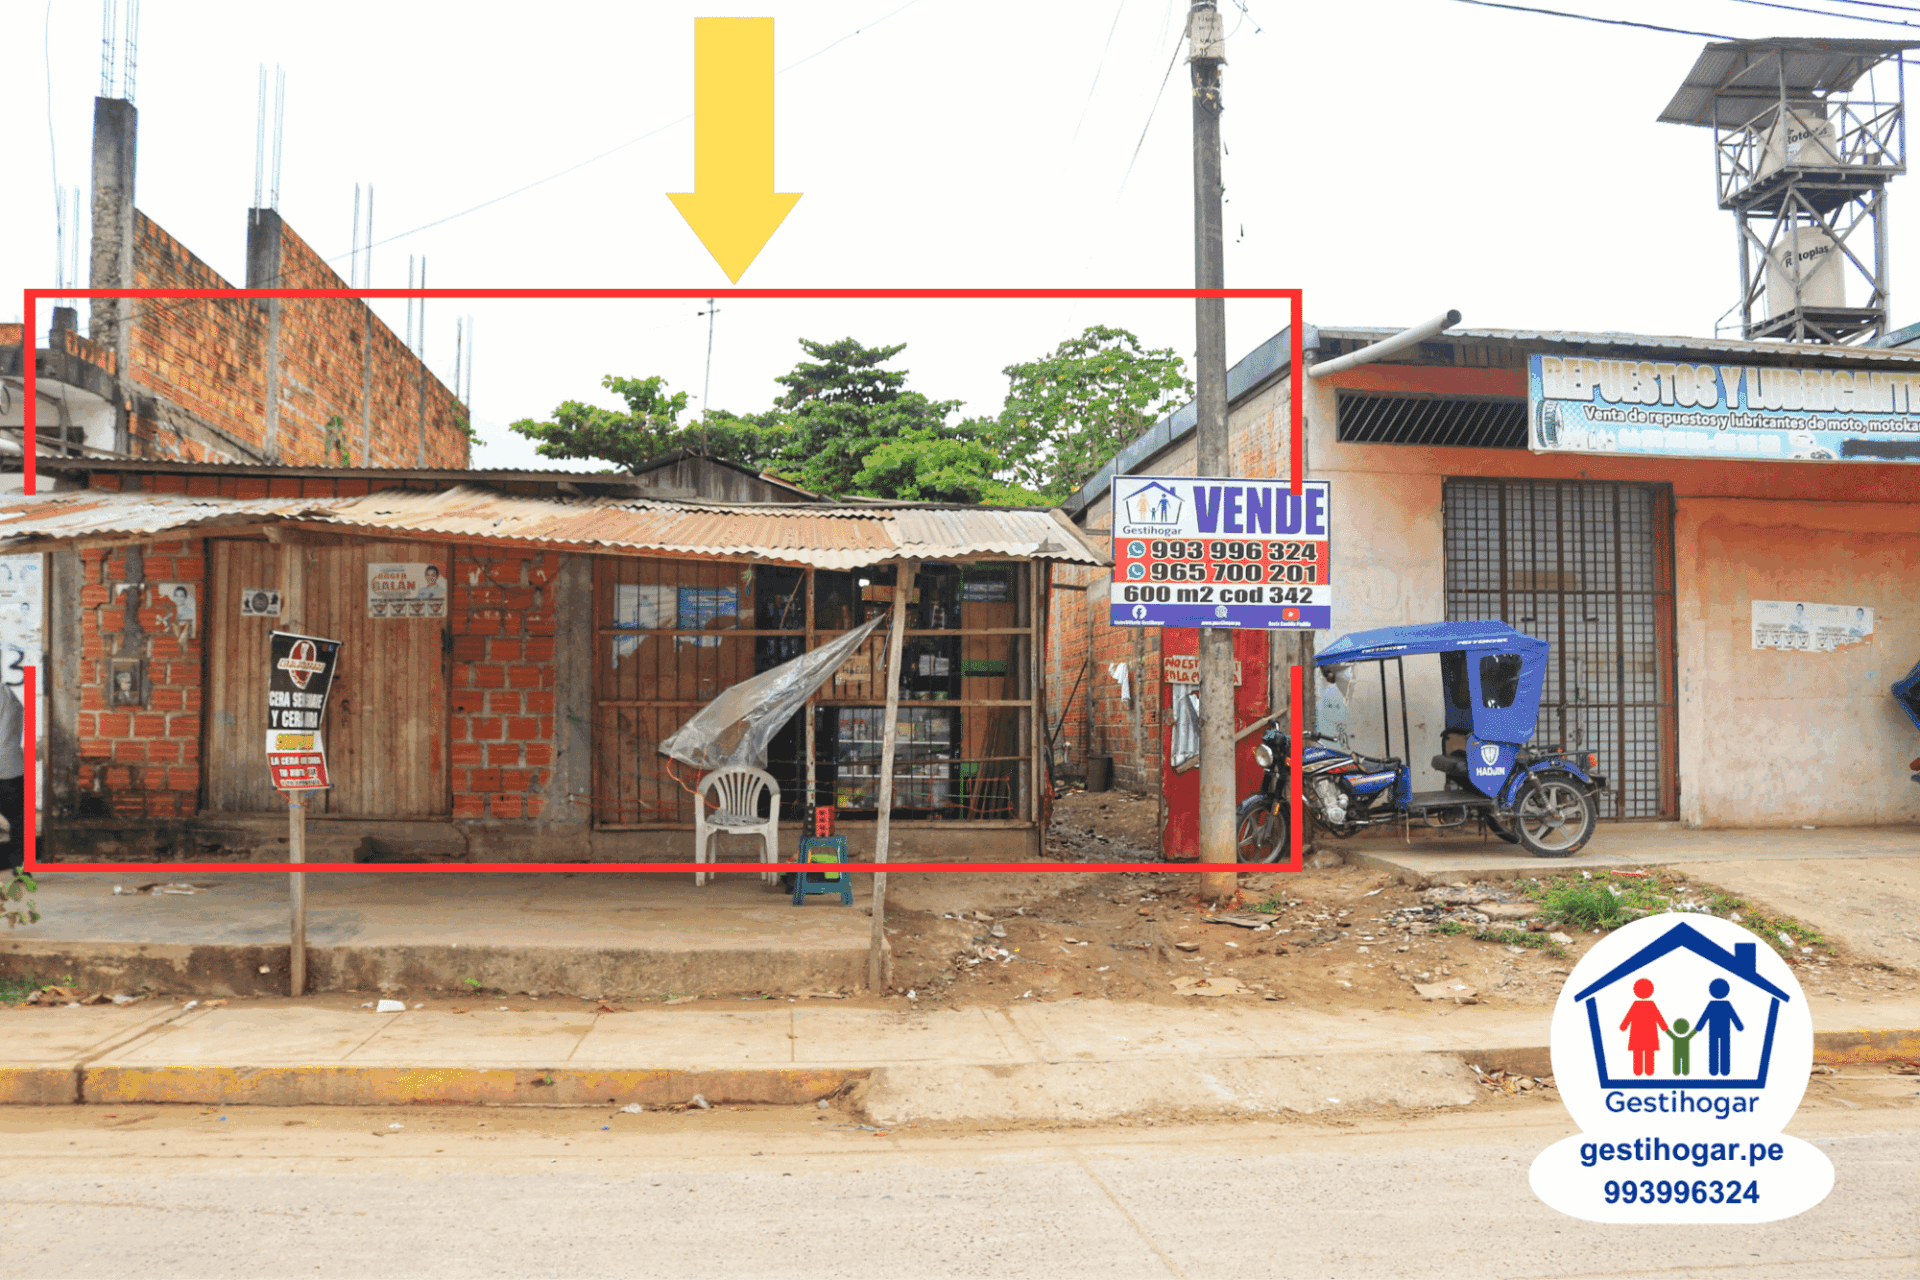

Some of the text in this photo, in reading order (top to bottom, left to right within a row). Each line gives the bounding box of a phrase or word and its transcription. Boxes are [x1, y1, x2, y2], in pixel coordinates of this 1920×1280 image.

[1785, 245, 1829, 268] Rtoplas
[1541, 356, 1719, 409] REPUESTOS
[1719, 364, 1743, 410] Y
[1582, 404, 1627, 422] Venta
[1628, 406, 1648, 423] de
[1649, 412, 1717, 428] repuestos
[1717, 413, 1730, 430] y
[1730, 411, 1806, 430] lubricantes
[1807, 415, 1826, 430] de
[1828, 420, 1868, 433] moto,
[1193, 486, 1325, 535] VENDE
[1122, 525, 1183, 536] Gestihogar
[1151, 540, 1318, 562] 993 996 324
[1151, 562, 1317, 583] 965 700 201
[1124, 585, 1313, 604] 600 m2 cod 342
[269, 690, 291, 707] CERA
[271, 709, 279, 728] Y
